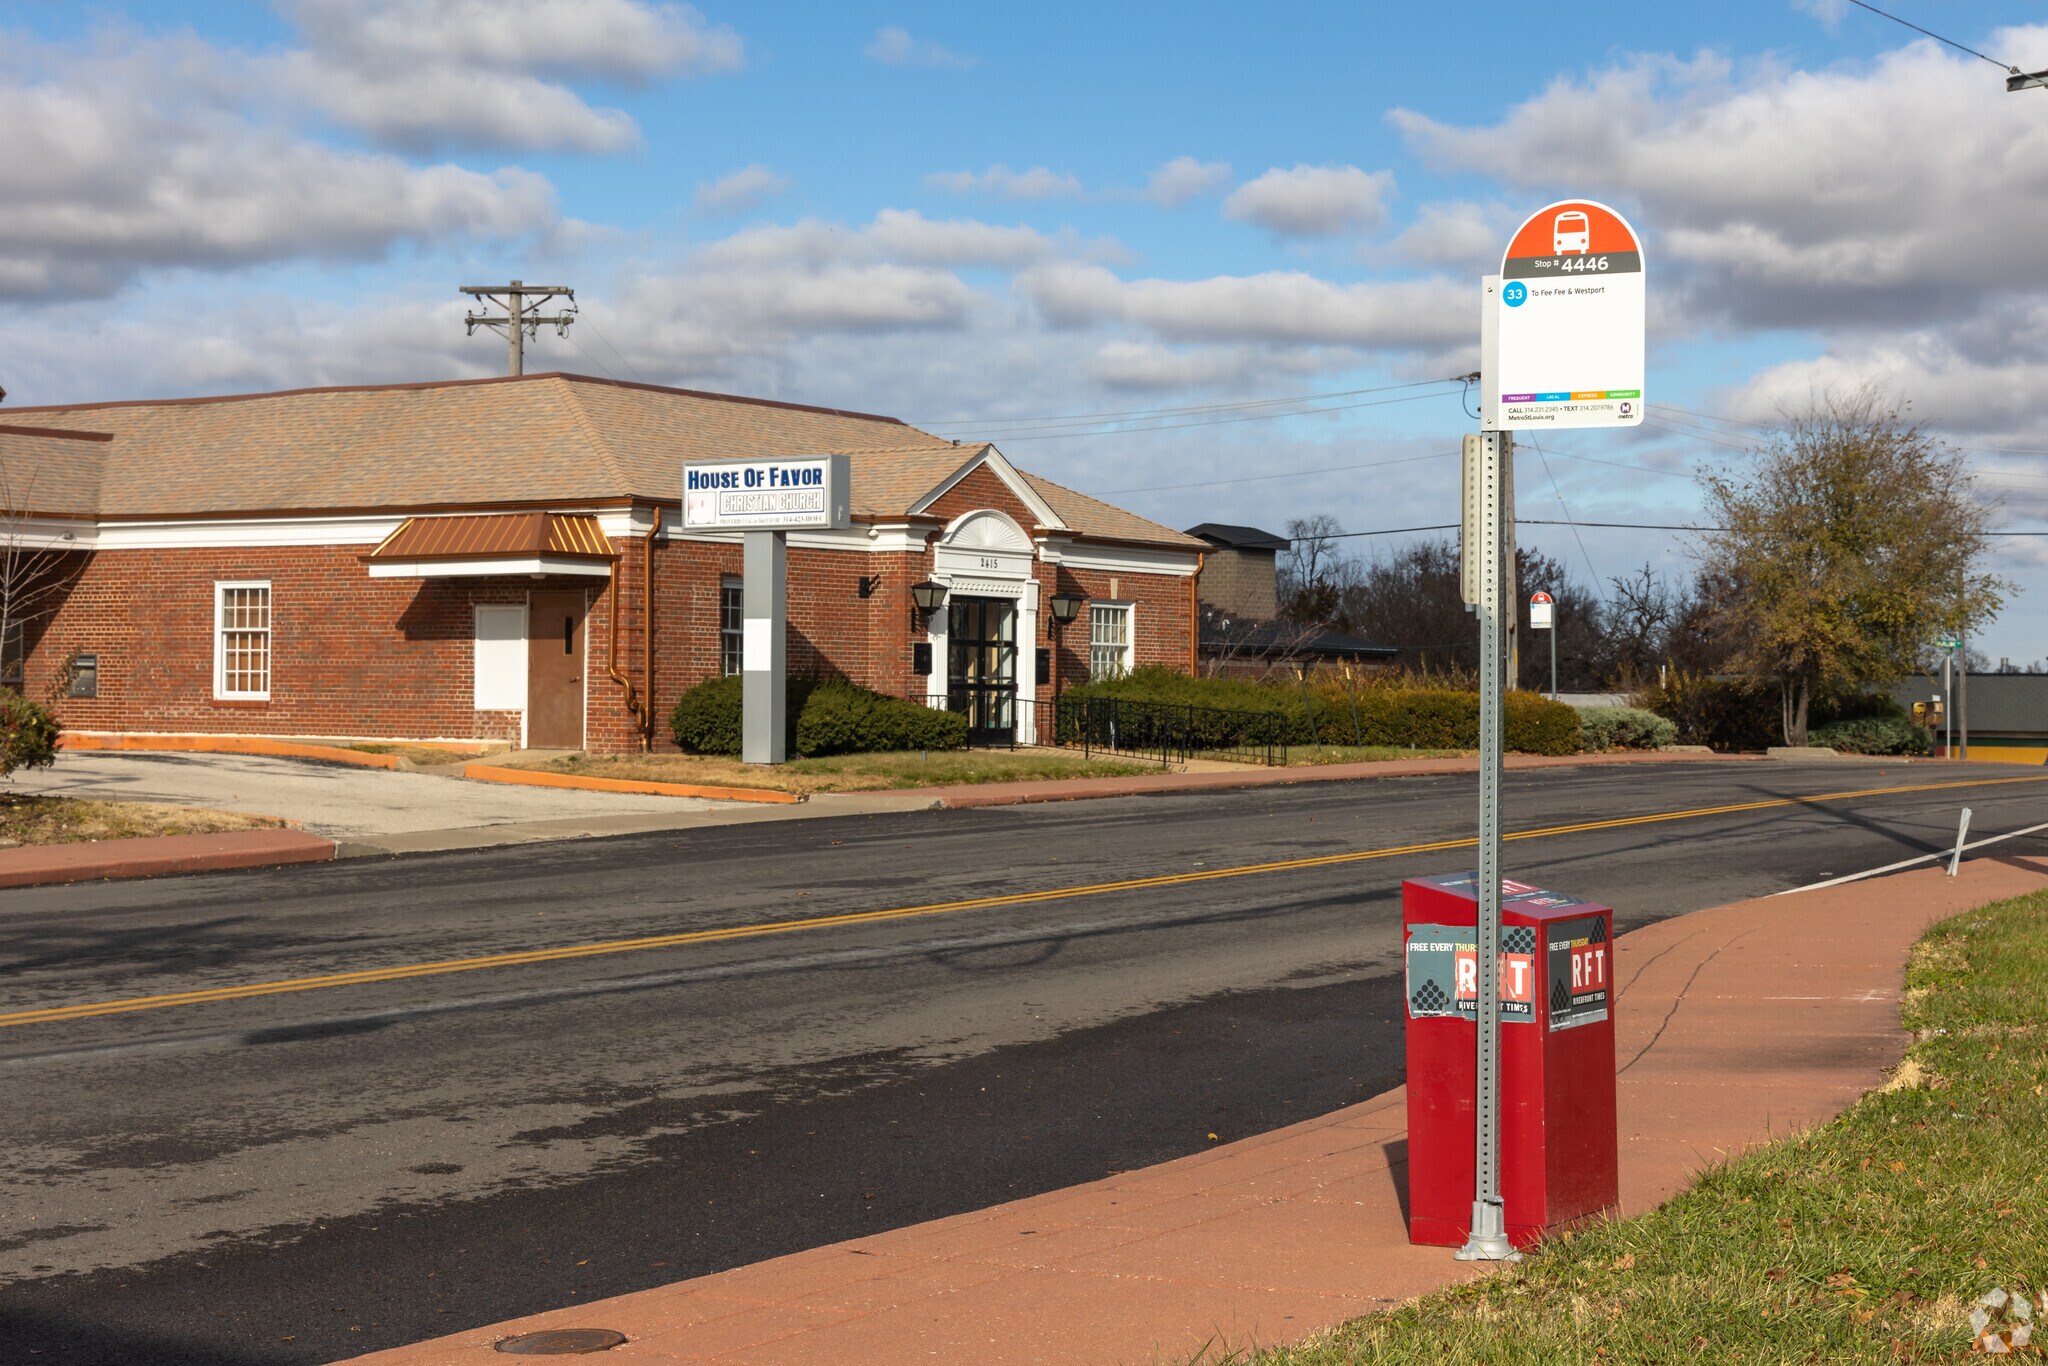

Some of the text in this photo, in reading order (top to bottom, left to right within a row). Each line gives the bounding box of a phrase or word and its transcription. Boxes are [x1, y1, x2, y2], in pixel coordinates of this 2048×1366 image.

[1534, 260, 1552, 268] Stop
[1562, 256, 1608, 272] 4446
[1508, 289, 1522, 300] 33
[1575, 287, 1604, 295] Westport
[723, 492, 820, 512] CHRISTIAN CHURCH
[980, 558, 998, 568] 2415
[1410, 943, 1428, 952] FREE
[1430, 943, 1454, 952] EVERY
[1572, 950, 1604, 988] RFT
[1458, 958, 1528, 995] RT
[1594, 992, 1605, 1000] TIMES
[1506, 1003, 1528, 1013] TIMES
